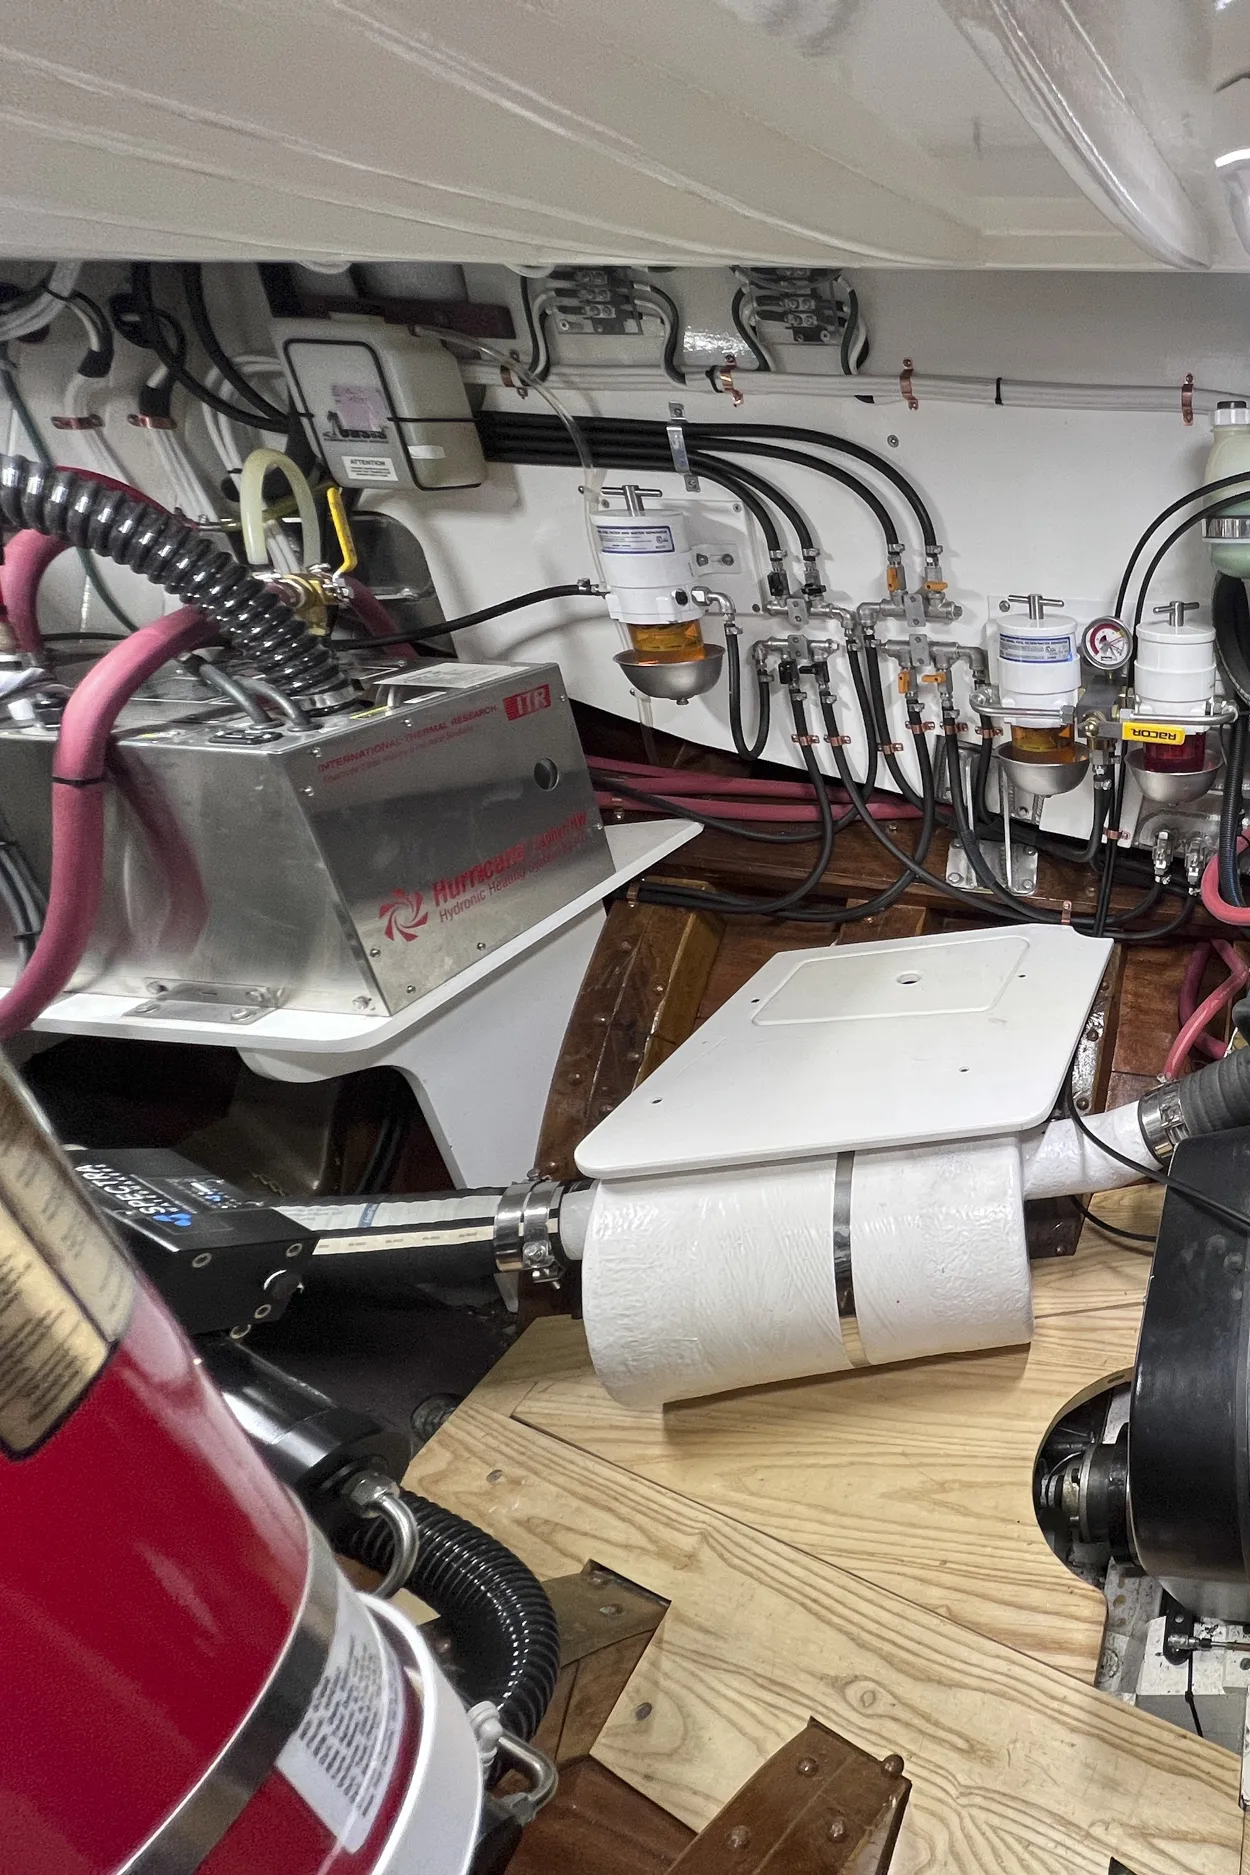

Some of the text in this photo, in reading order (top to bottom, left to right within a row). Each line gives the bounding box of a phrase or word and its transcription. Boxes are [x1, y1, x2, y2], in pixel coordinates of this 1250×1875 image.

[350, 458, 386, 466] ATTENTION
[515, 689, 548, 715] ITR
[319, 739, 400, 772] INTERNATIONAL
[403, 721, 449, 744] THERMAL
[451, 704, 497, 726] RESEARCH
[432, 843, 526, 908] Hurricane
[438, 889, 486, 924] Hydronic
[74, 1163, 167, 1215] SPECTRA
